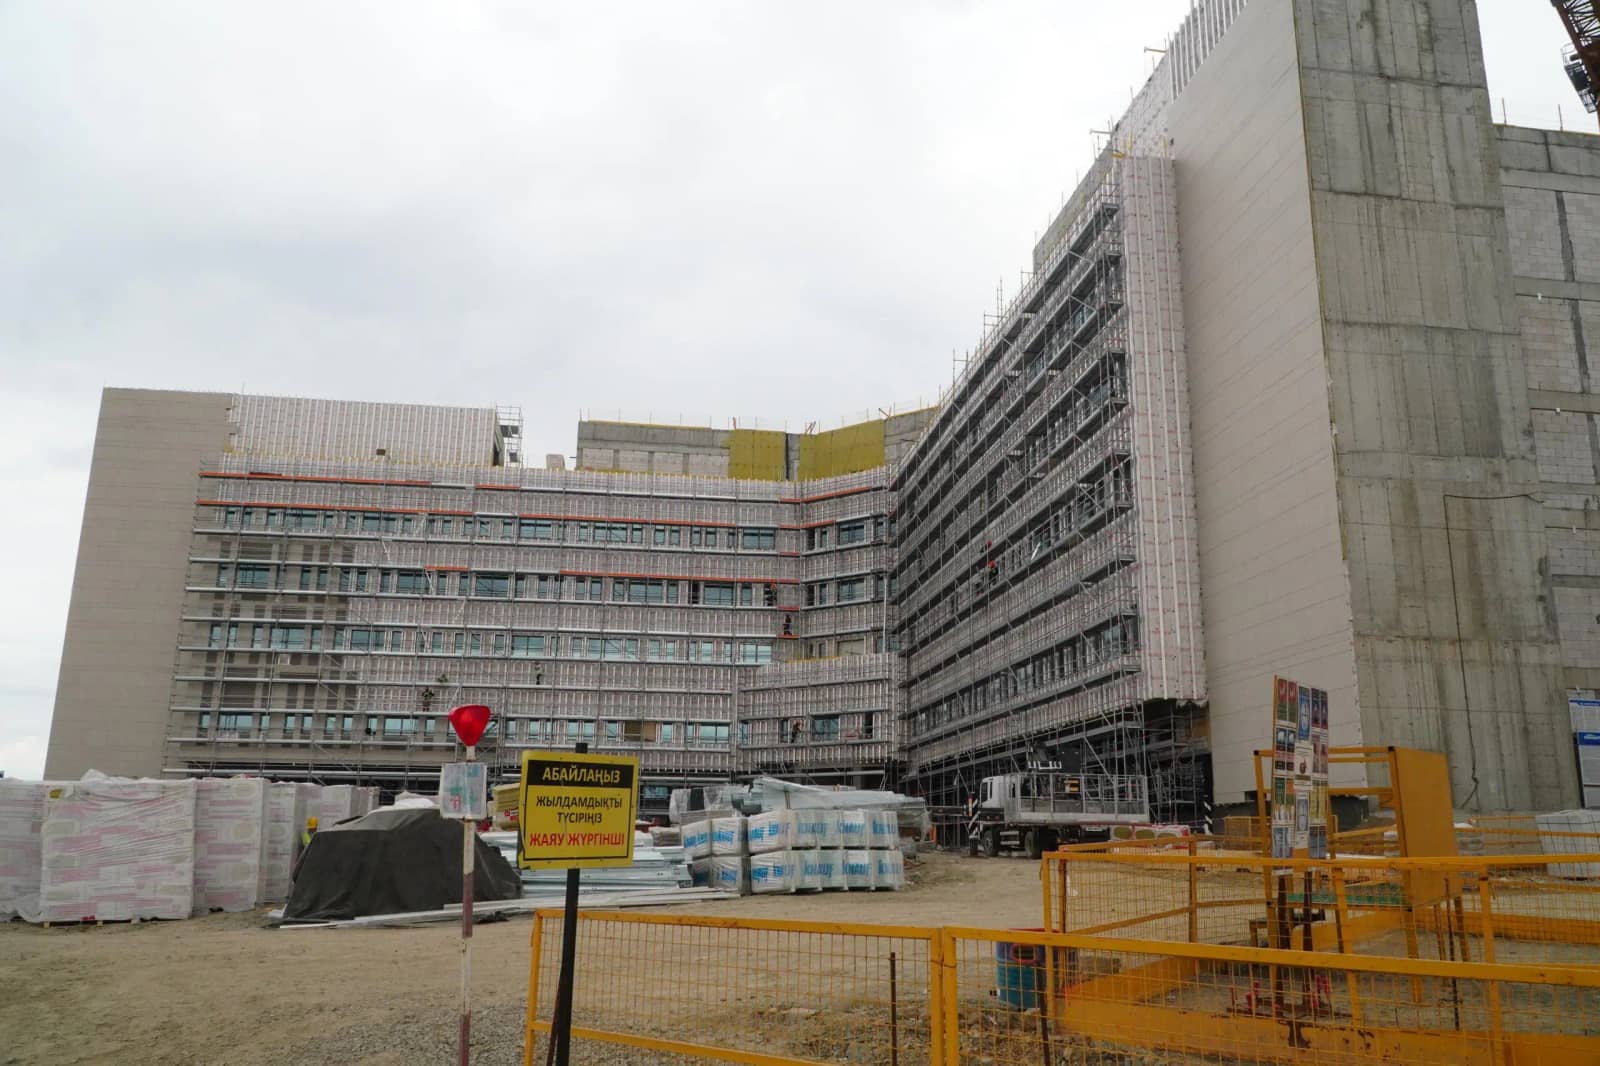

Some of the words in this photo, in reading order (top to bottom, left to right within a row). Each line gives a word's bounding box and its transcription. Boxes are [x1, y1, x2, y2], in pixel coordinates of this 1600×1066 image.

[542, 764, 621, 785] АБАЙЛАҢЫЗ
[535, 794, 623, 811] ЖЫЛДАМДЫҚТЫ
[556, 811, 603, 826] ТҮСІРІҢІЗ
[529, 832, 565, 847] ЖАЯУ
[567, 832, 625, 847] ЖҮРГІНШІ
